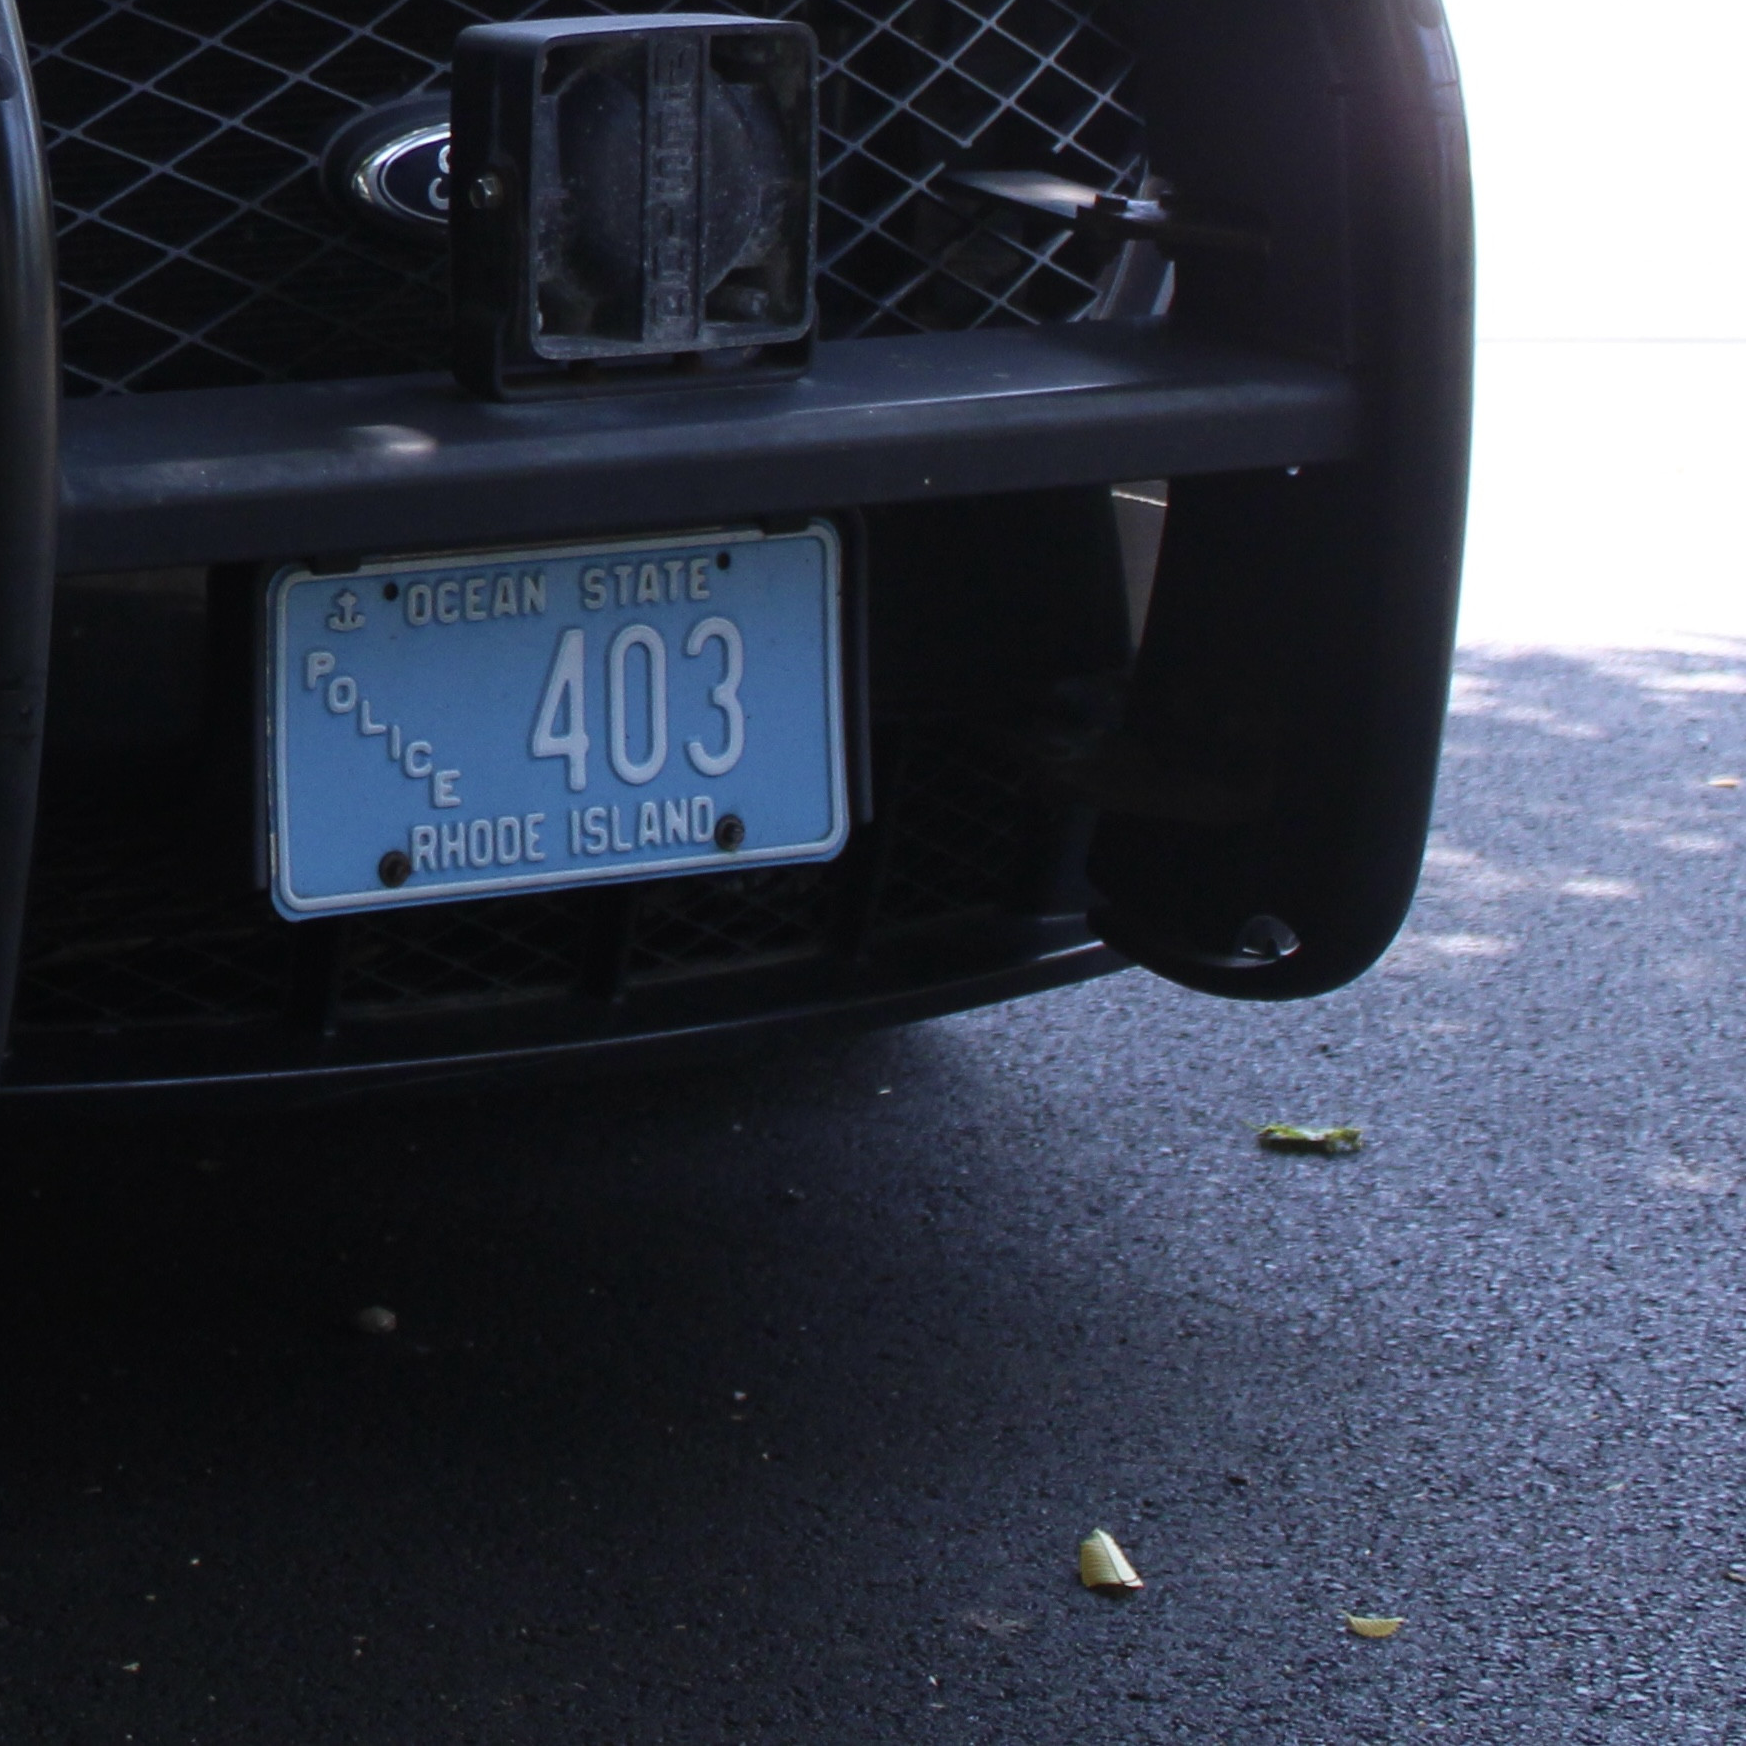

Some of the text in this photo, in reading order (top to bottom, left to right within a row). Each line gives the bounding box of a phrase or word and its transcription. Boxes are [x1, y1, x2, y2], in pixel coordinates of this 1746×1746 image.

[407, 559, 710, 626] OCEAN STATE
[306, 651, 462, 808] POLICE
[531, 616, 744, 792] 403
[410, 795, 714, 872] RHODE ISLAND
